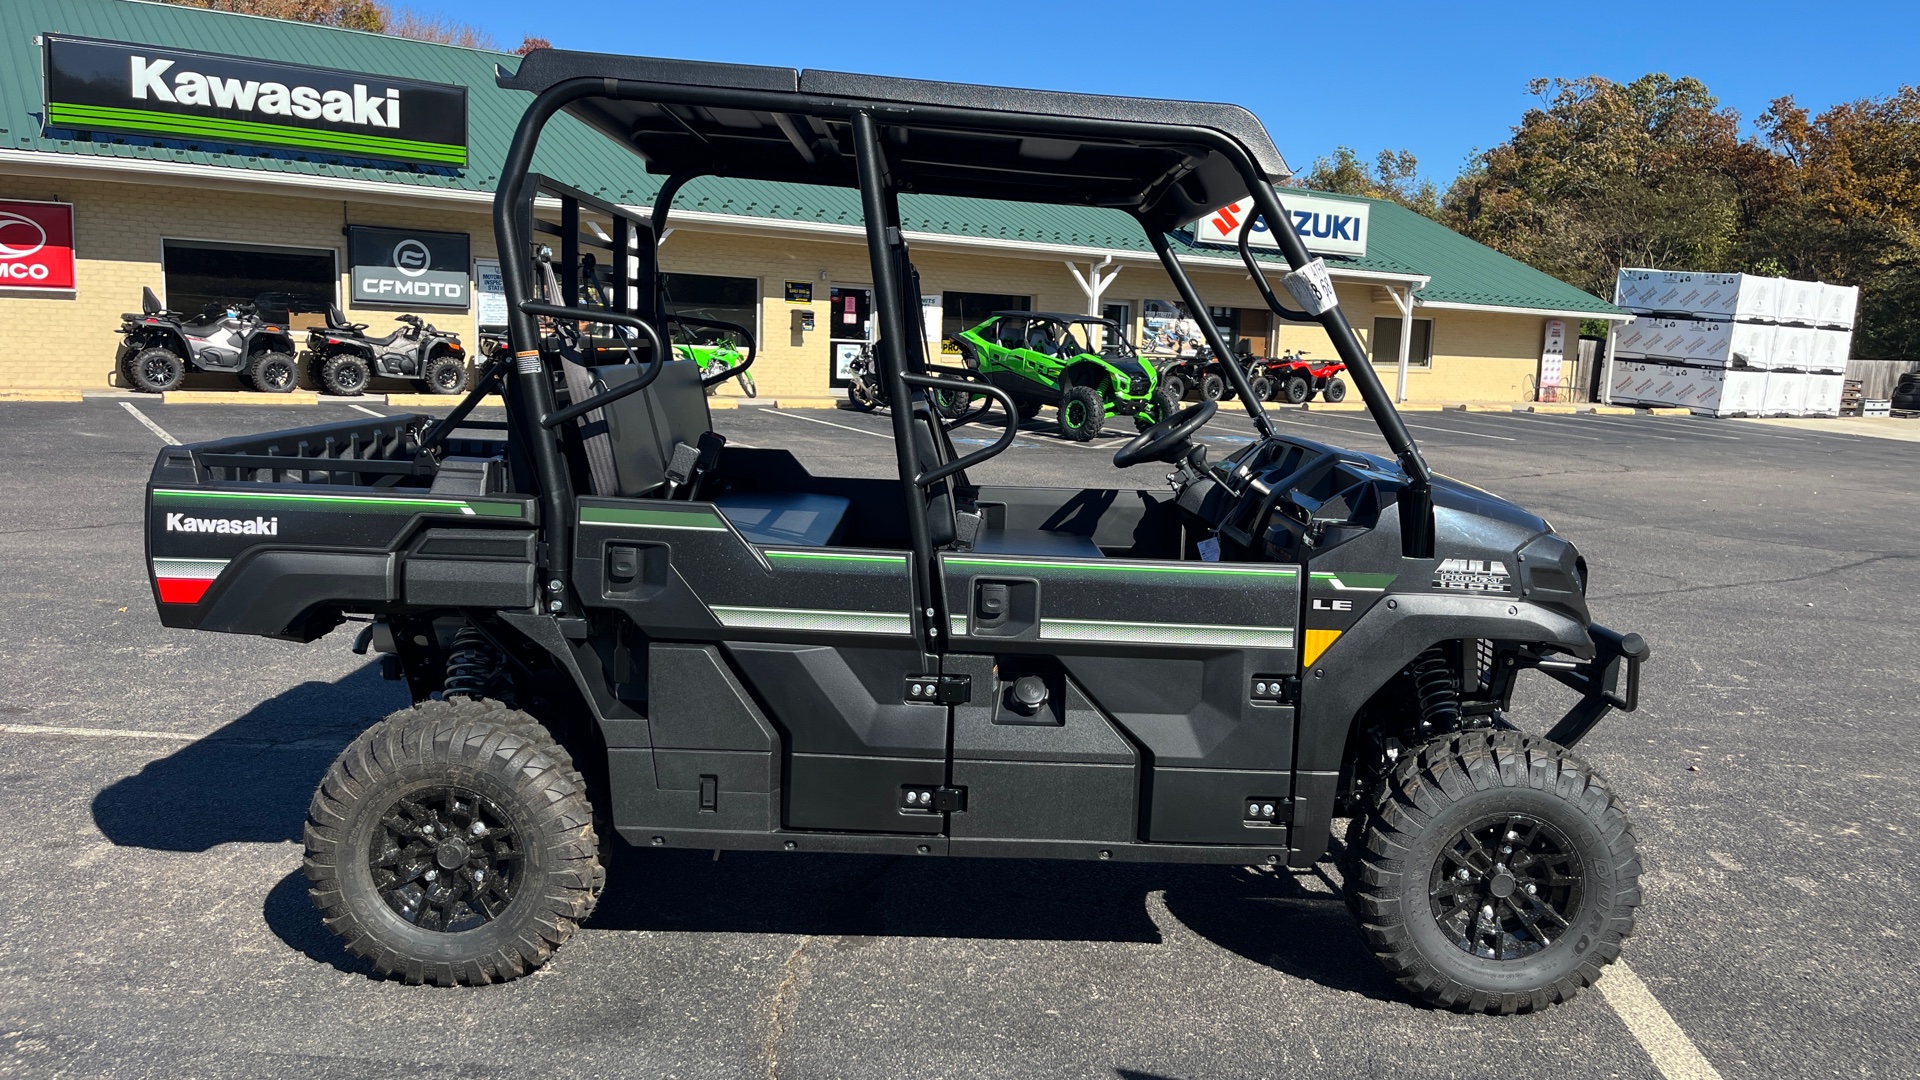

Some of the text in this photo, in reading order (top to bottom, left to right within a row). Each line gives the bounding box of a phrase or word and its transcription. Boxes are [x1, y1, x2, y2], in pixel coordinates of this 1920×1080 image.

[131, 55, 400, 129] Kawasaki
[1251, 209, 1361, 241] ZUKI
[0, 262, 49, 280] MCO
[362, 278, 462, 298] CFMOTO
[166, 512, 278, 535] Kawasaki
[1434, 558, 1511, 578] MULE
[1312, 599, 1353, 611] LE
[1572, 857, 1611, 957] DURO
